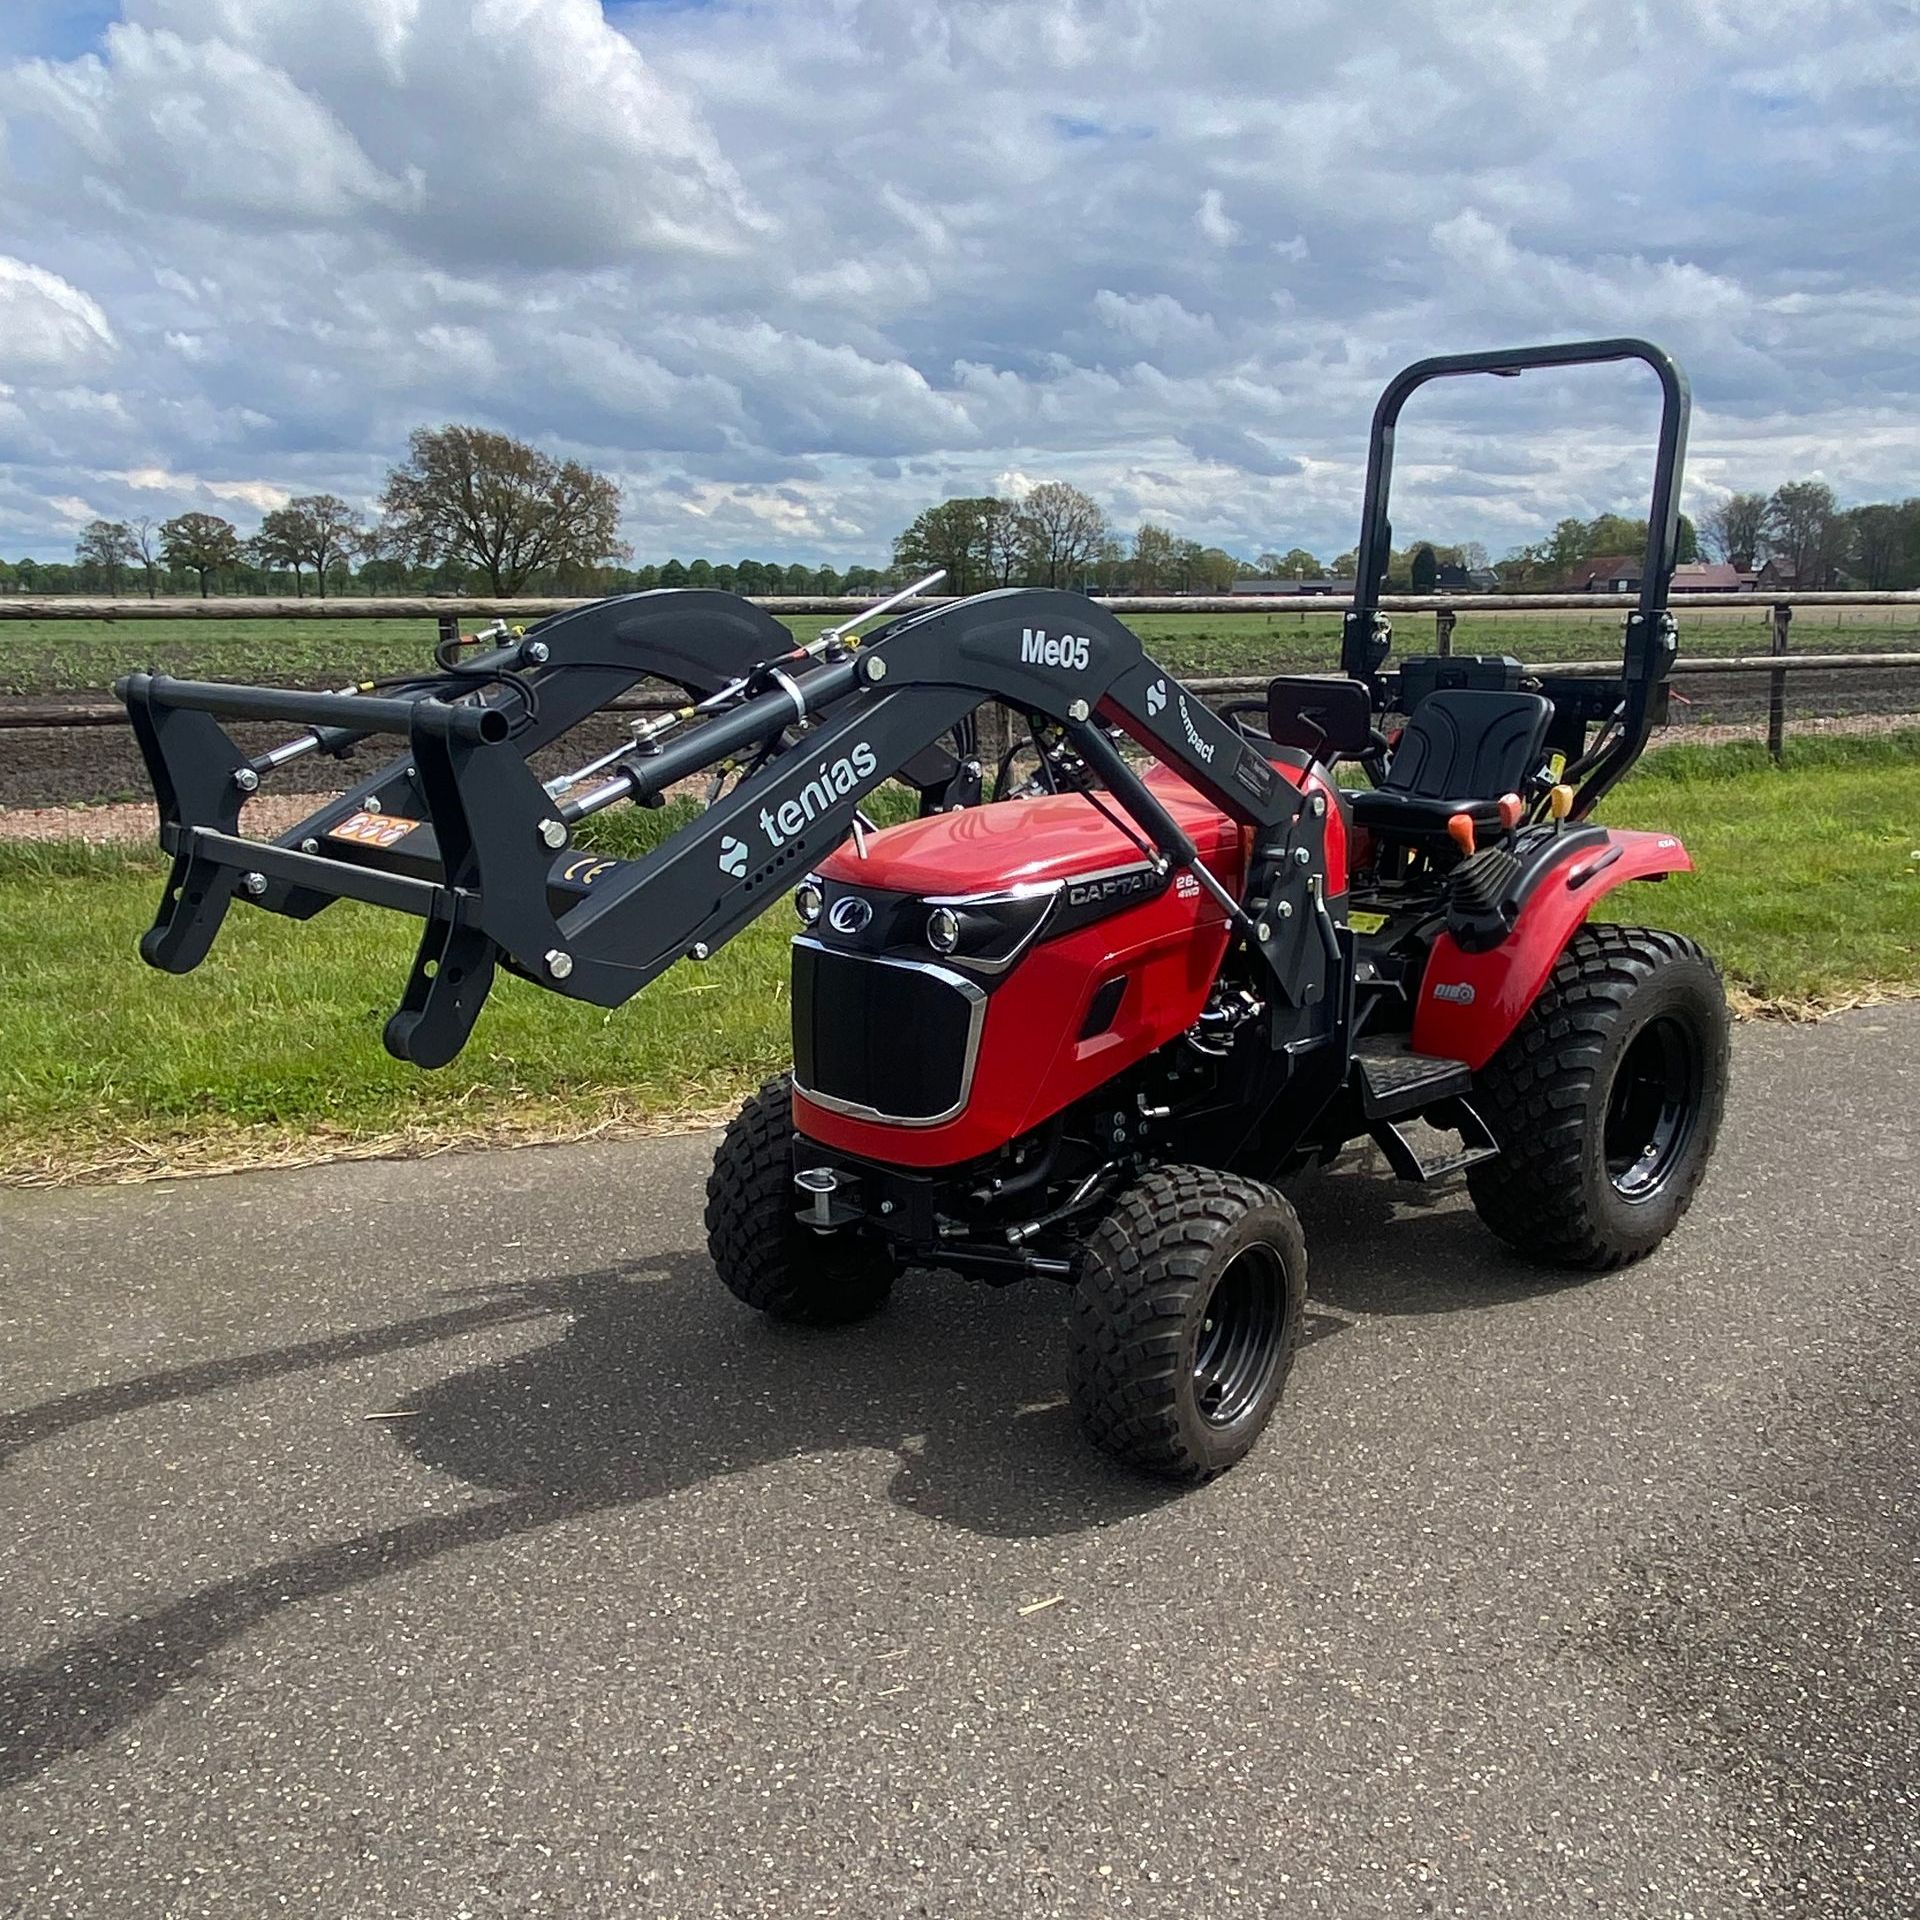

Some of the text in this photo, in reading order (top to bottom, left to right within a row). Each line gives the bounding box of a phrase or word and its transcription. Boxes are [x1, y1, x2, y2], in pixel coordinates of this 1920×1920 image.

[1021, 628, 1090, 671] Me05
[1178, 694, 1215, 764] compact
[759, 742, 877, 847] tenías
